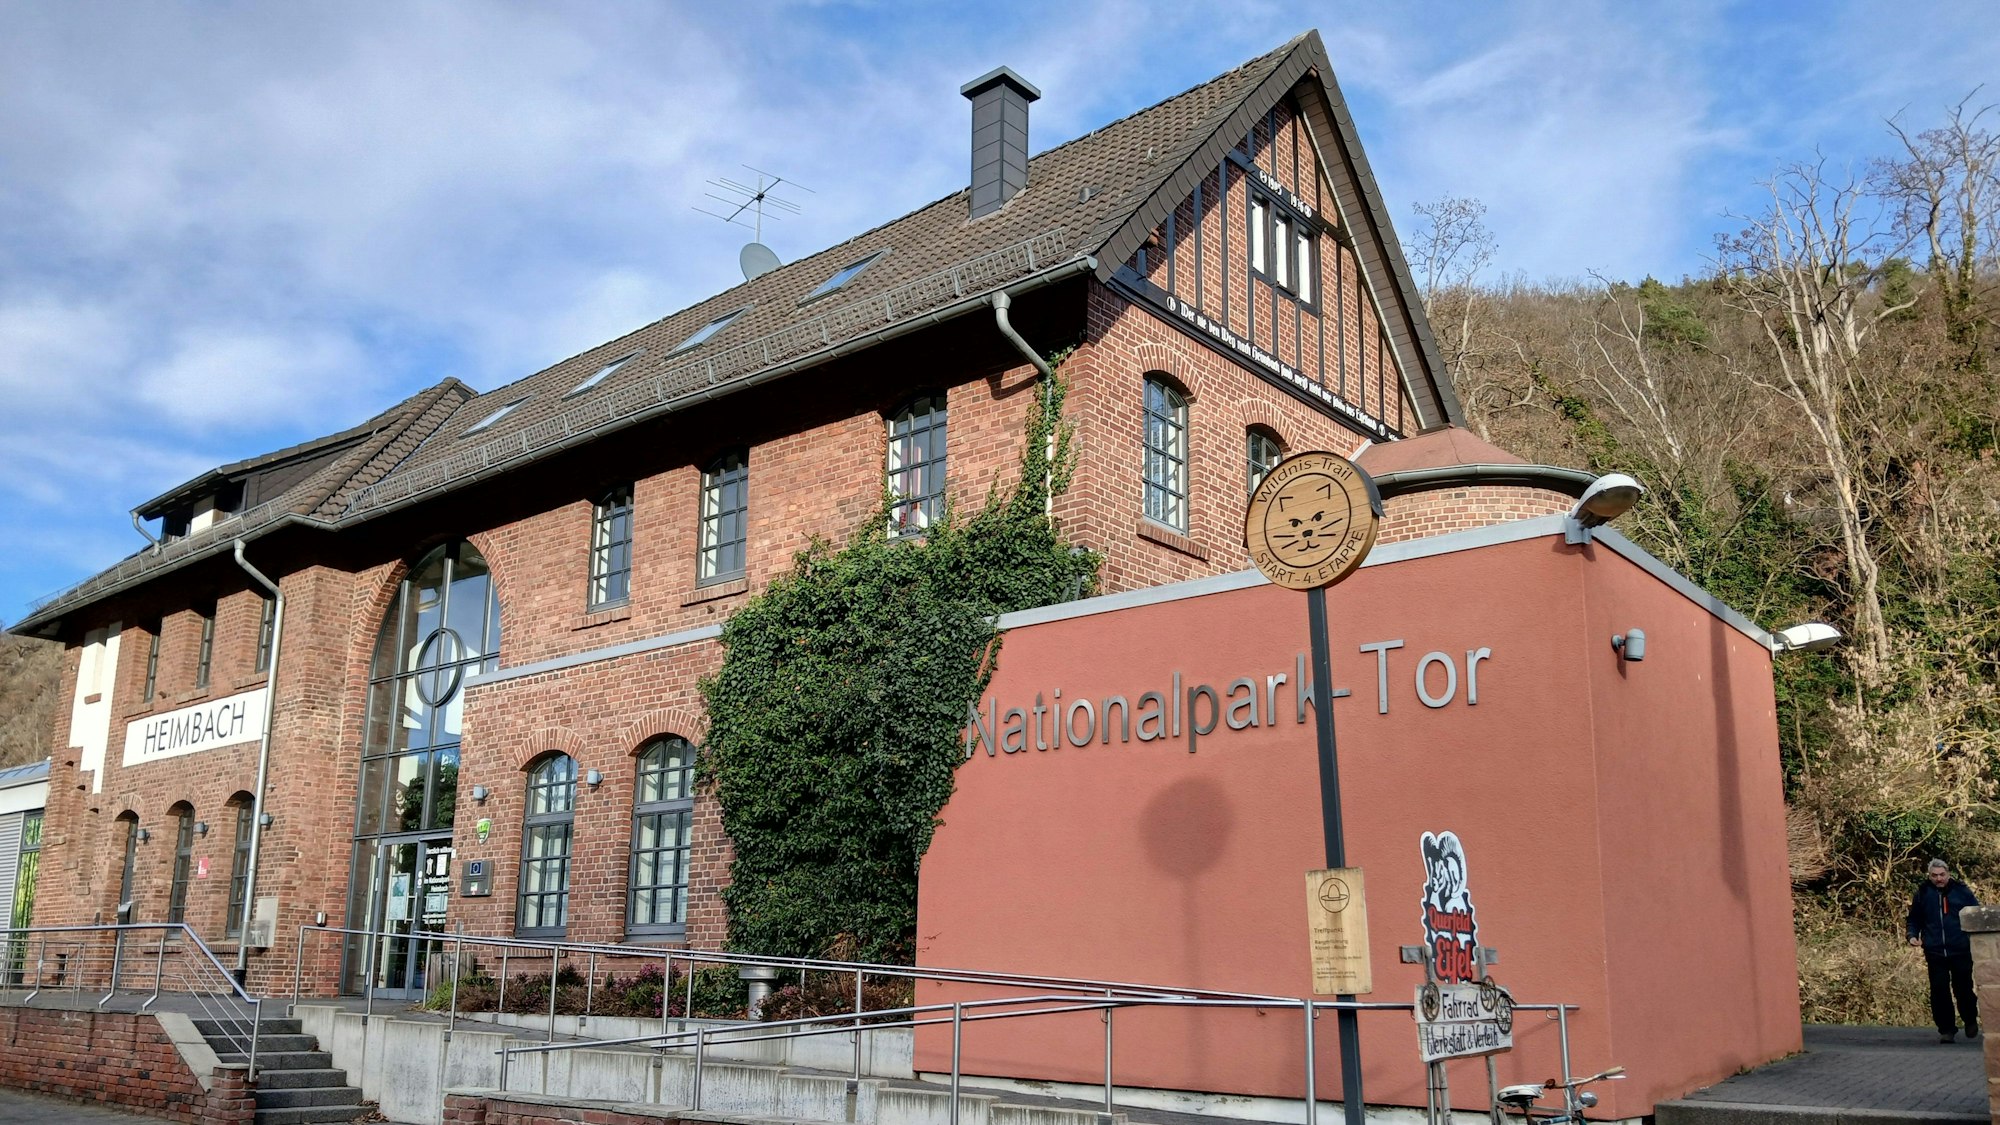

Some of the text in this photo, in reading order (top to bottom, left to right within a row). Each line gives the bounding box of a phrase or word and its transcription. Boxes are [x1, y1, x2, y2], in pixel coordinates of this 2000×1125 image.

[1257, 457, 1352, 503] Wildnis-Trail
[1318, 530, 1363, 580] ETAPPE
[143, 701, 246, 755] HEIMBACH
[1429, 905, 1471, 934] Querfeld
[1435, 938, 1472, 984] Eifel
[1442, 993, 1479, 1020] Fahrrad
[1426, 1025, 1499, 1056] Werkstatt & Verleih
